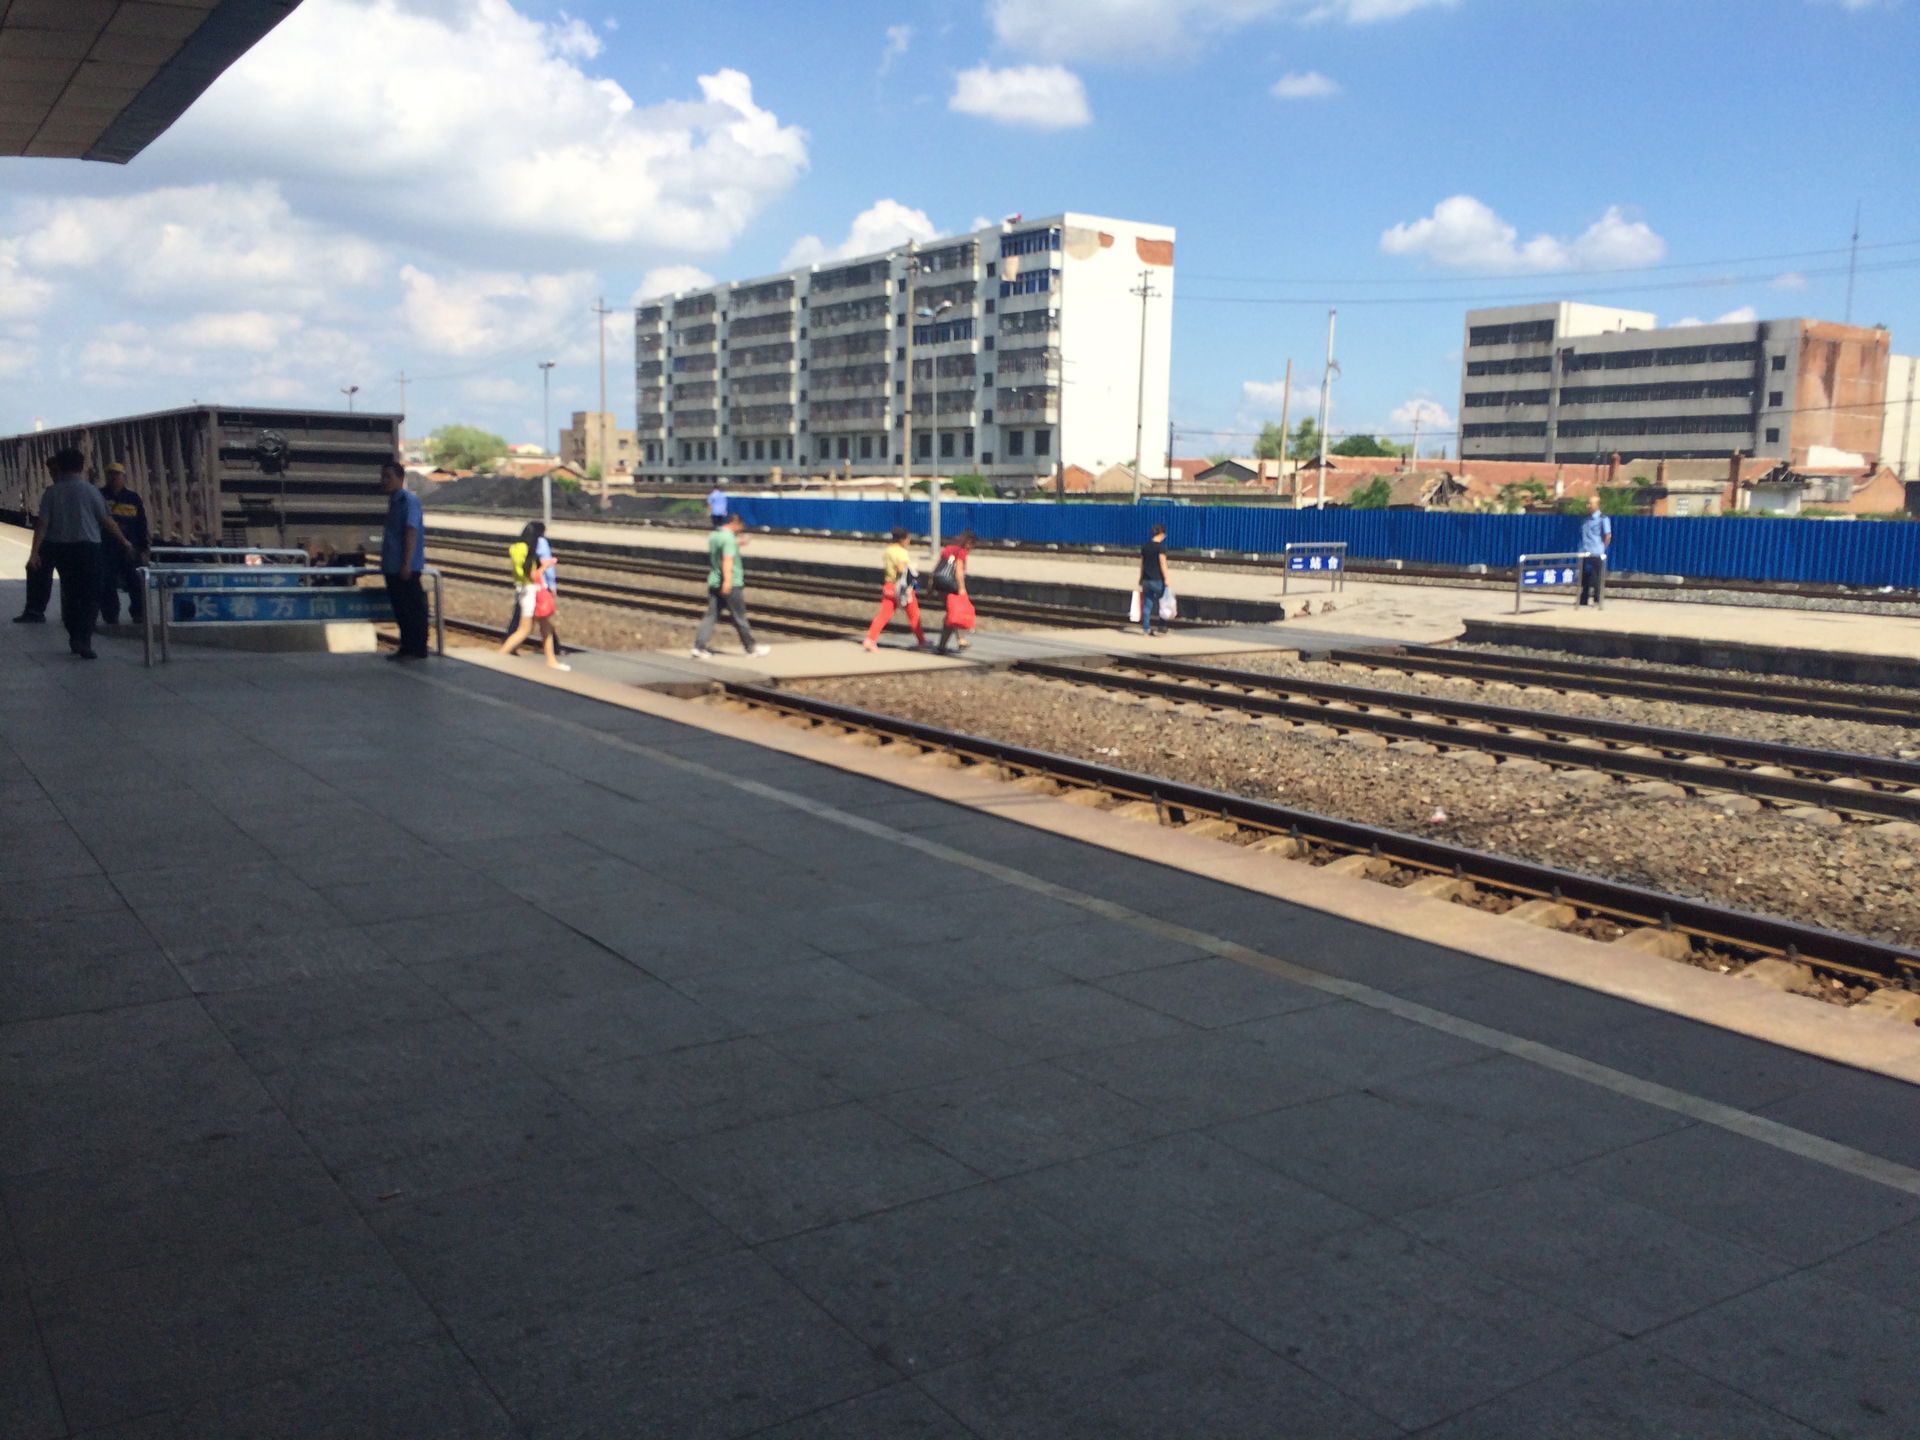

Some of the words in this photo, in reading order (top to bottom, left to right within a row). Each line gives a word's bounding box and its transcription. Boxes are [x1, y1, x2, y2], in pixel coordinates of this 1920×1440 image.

[1291, 556, 1339, 570] 二站台
[1524, 568, 1574, 584] 二站台
[193, 595, 336, 618] 长春方向
